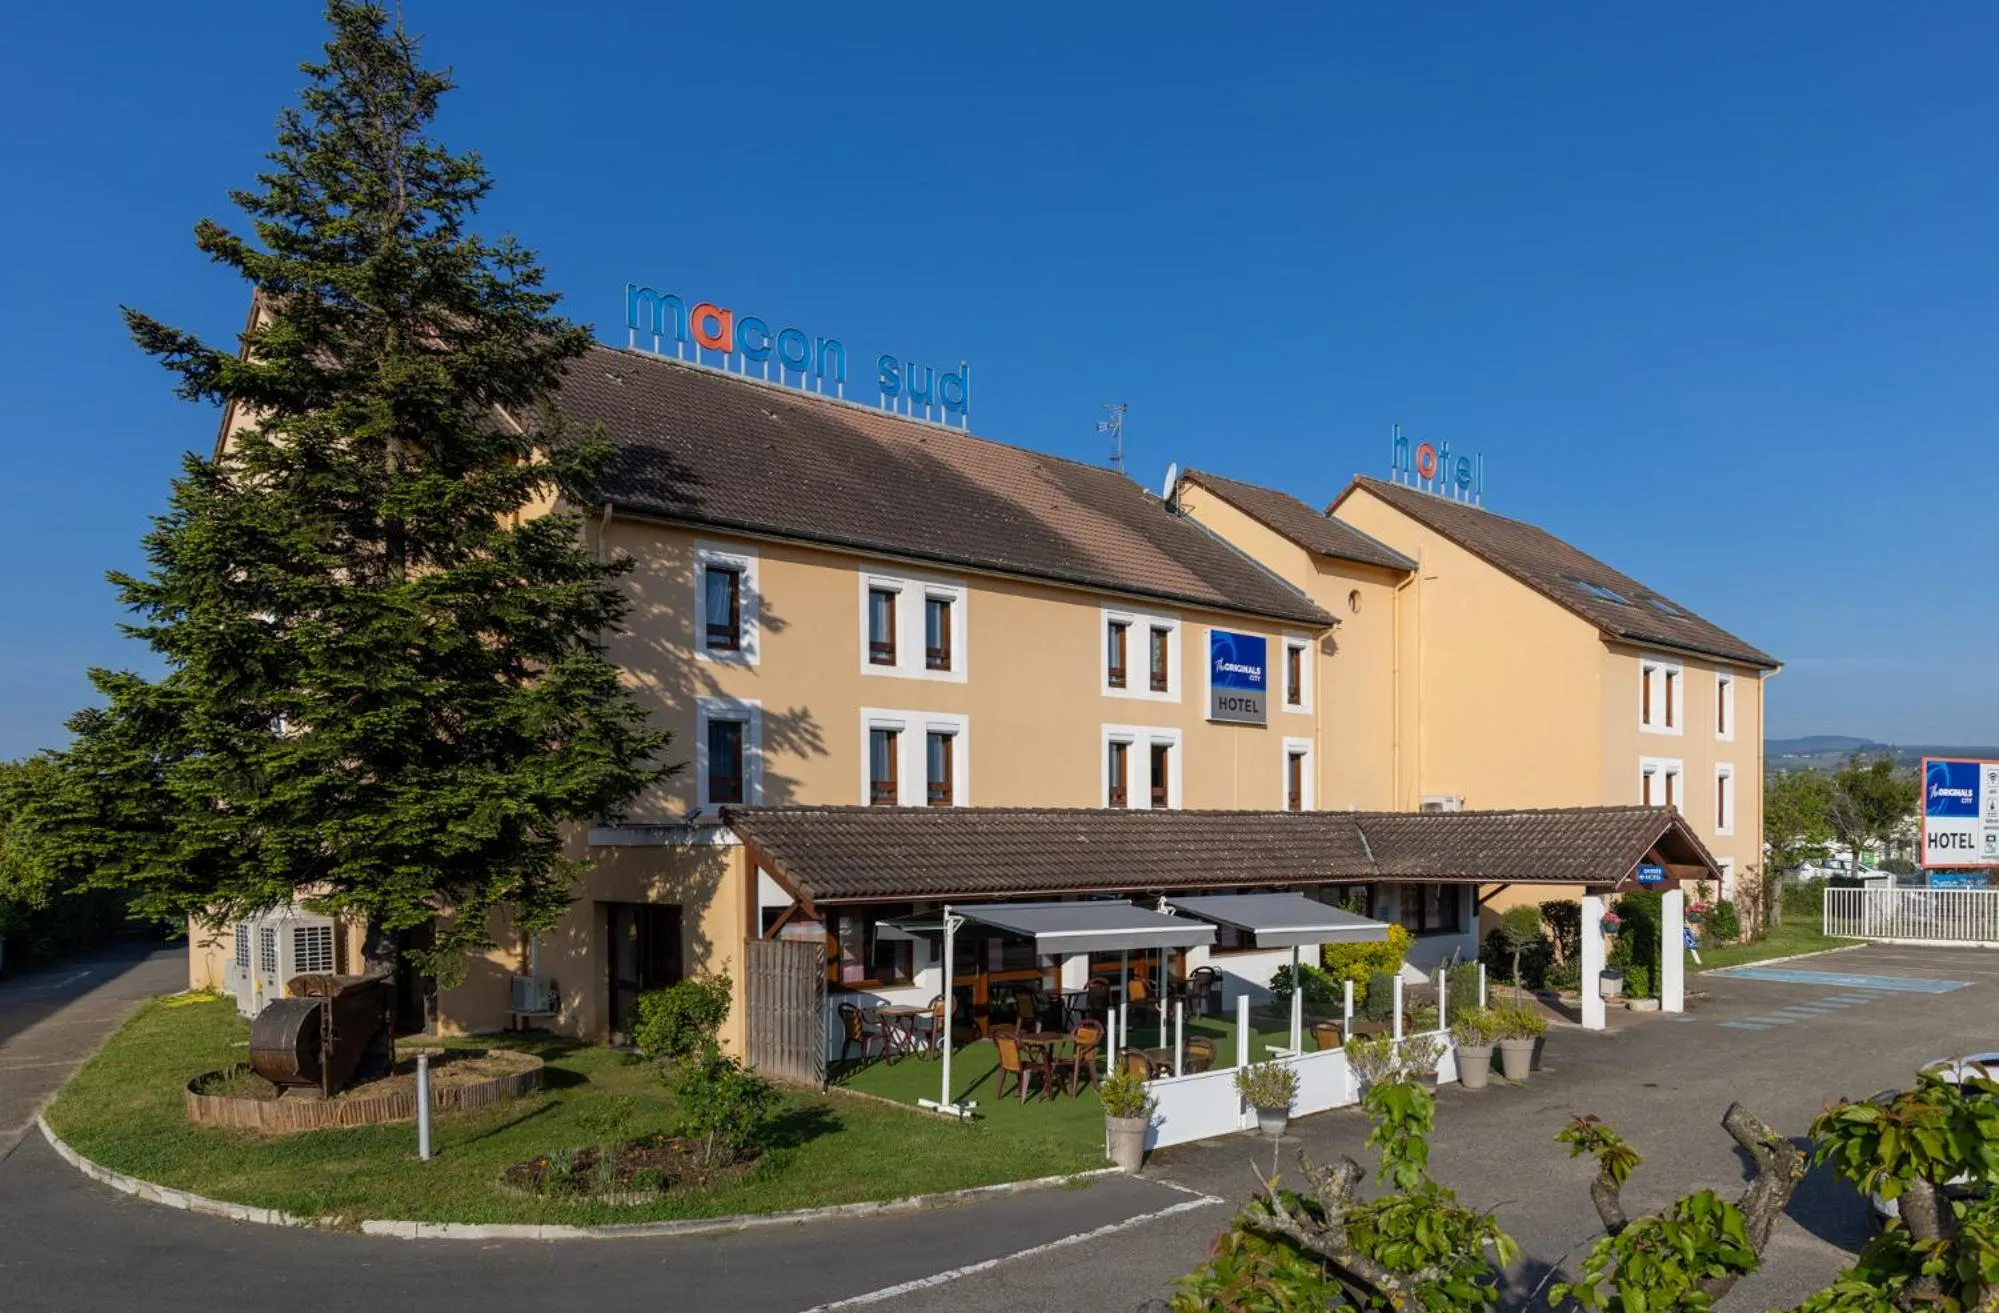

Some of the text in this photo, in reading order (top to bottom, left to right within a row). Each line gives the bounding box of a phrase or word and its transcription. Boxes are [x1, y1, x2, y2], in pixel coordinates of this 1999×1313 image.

[626, 283, 970, 415] macon sud
[1391, 424, 1483, 495] hotel
[1224, 663, 1261, 675] ORIGINALS
[1218, 697, 1259, 713] HOTEL
[1938, 788, 1973, 797] ORIGINALS
[1927, 832, 1975, 849] HOTEL
